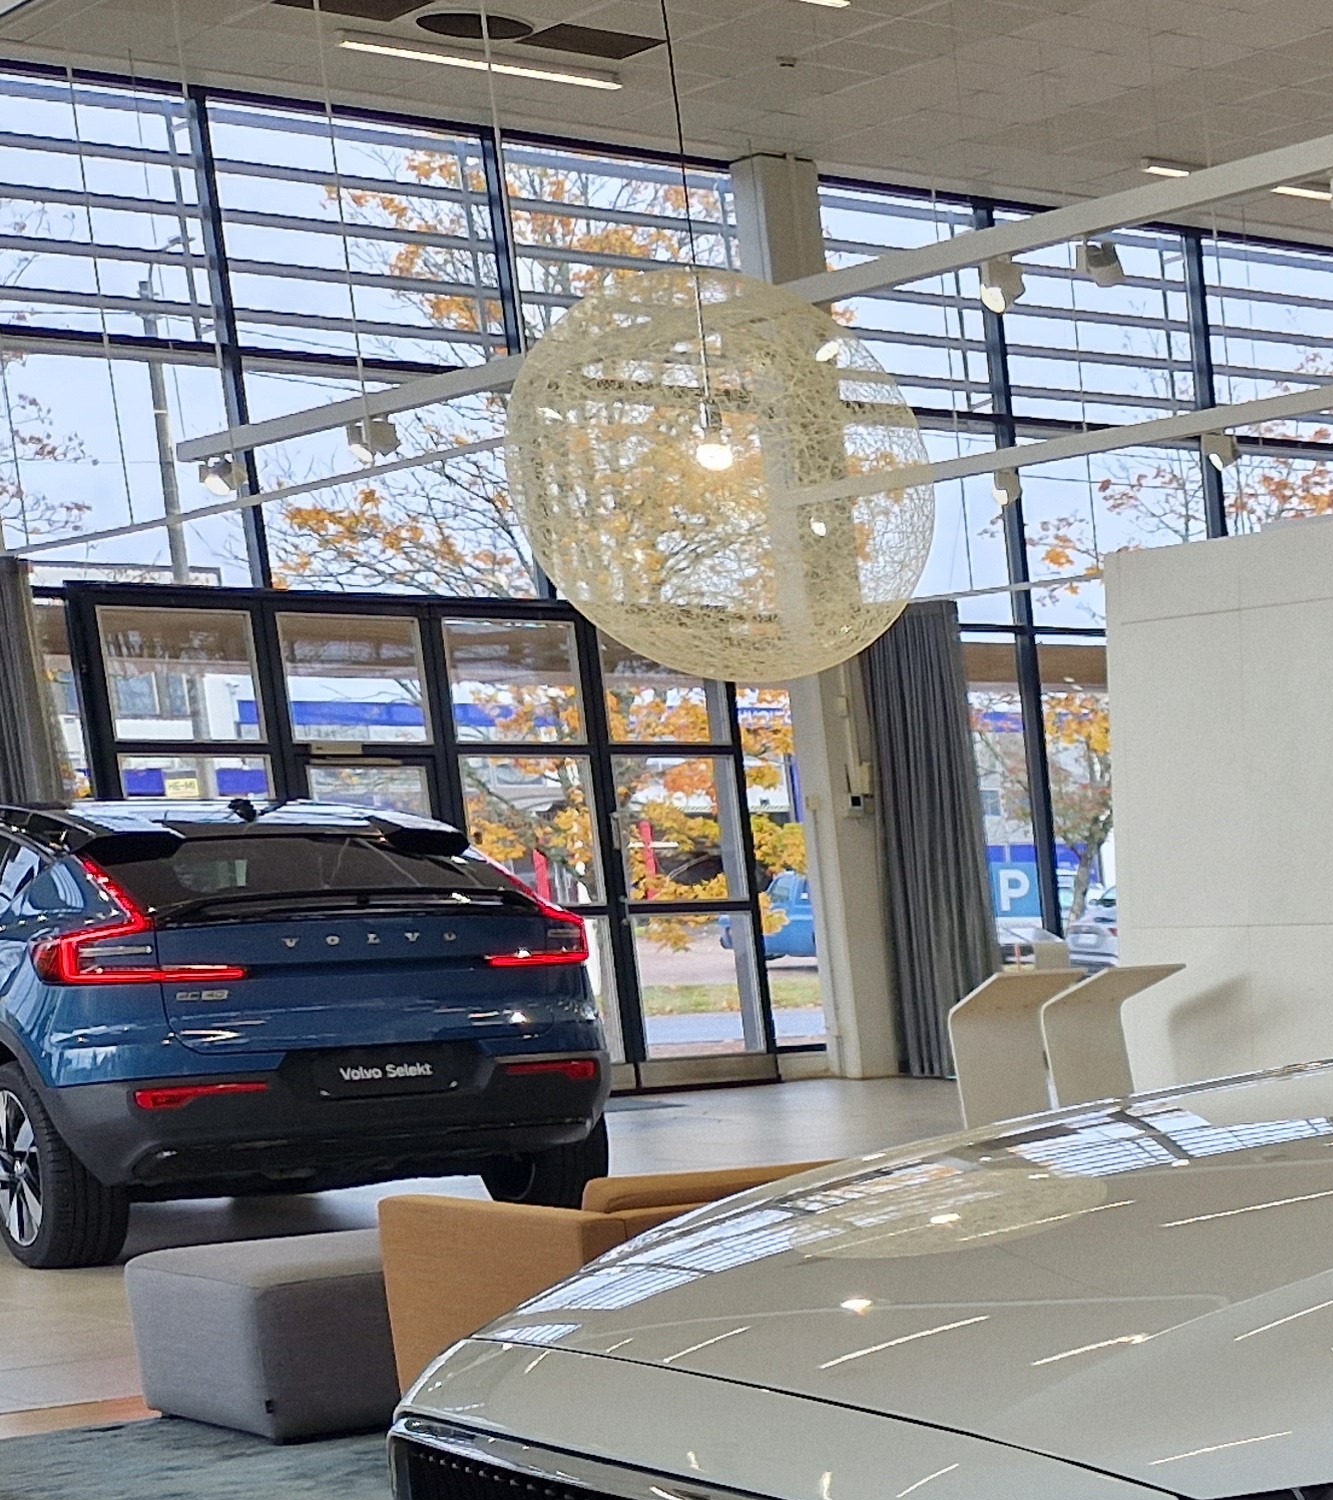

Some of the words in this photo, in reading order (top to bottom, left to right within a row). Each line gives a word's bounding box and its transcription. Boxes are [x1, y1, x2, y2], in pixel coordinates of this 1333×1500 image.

[999, 868, 1030, 912] P
[281, 931, 458, 949] VOLVO
[339, 1065, 383, 1081] Volvo
[385, 1062, 434, 1079] Selekt
